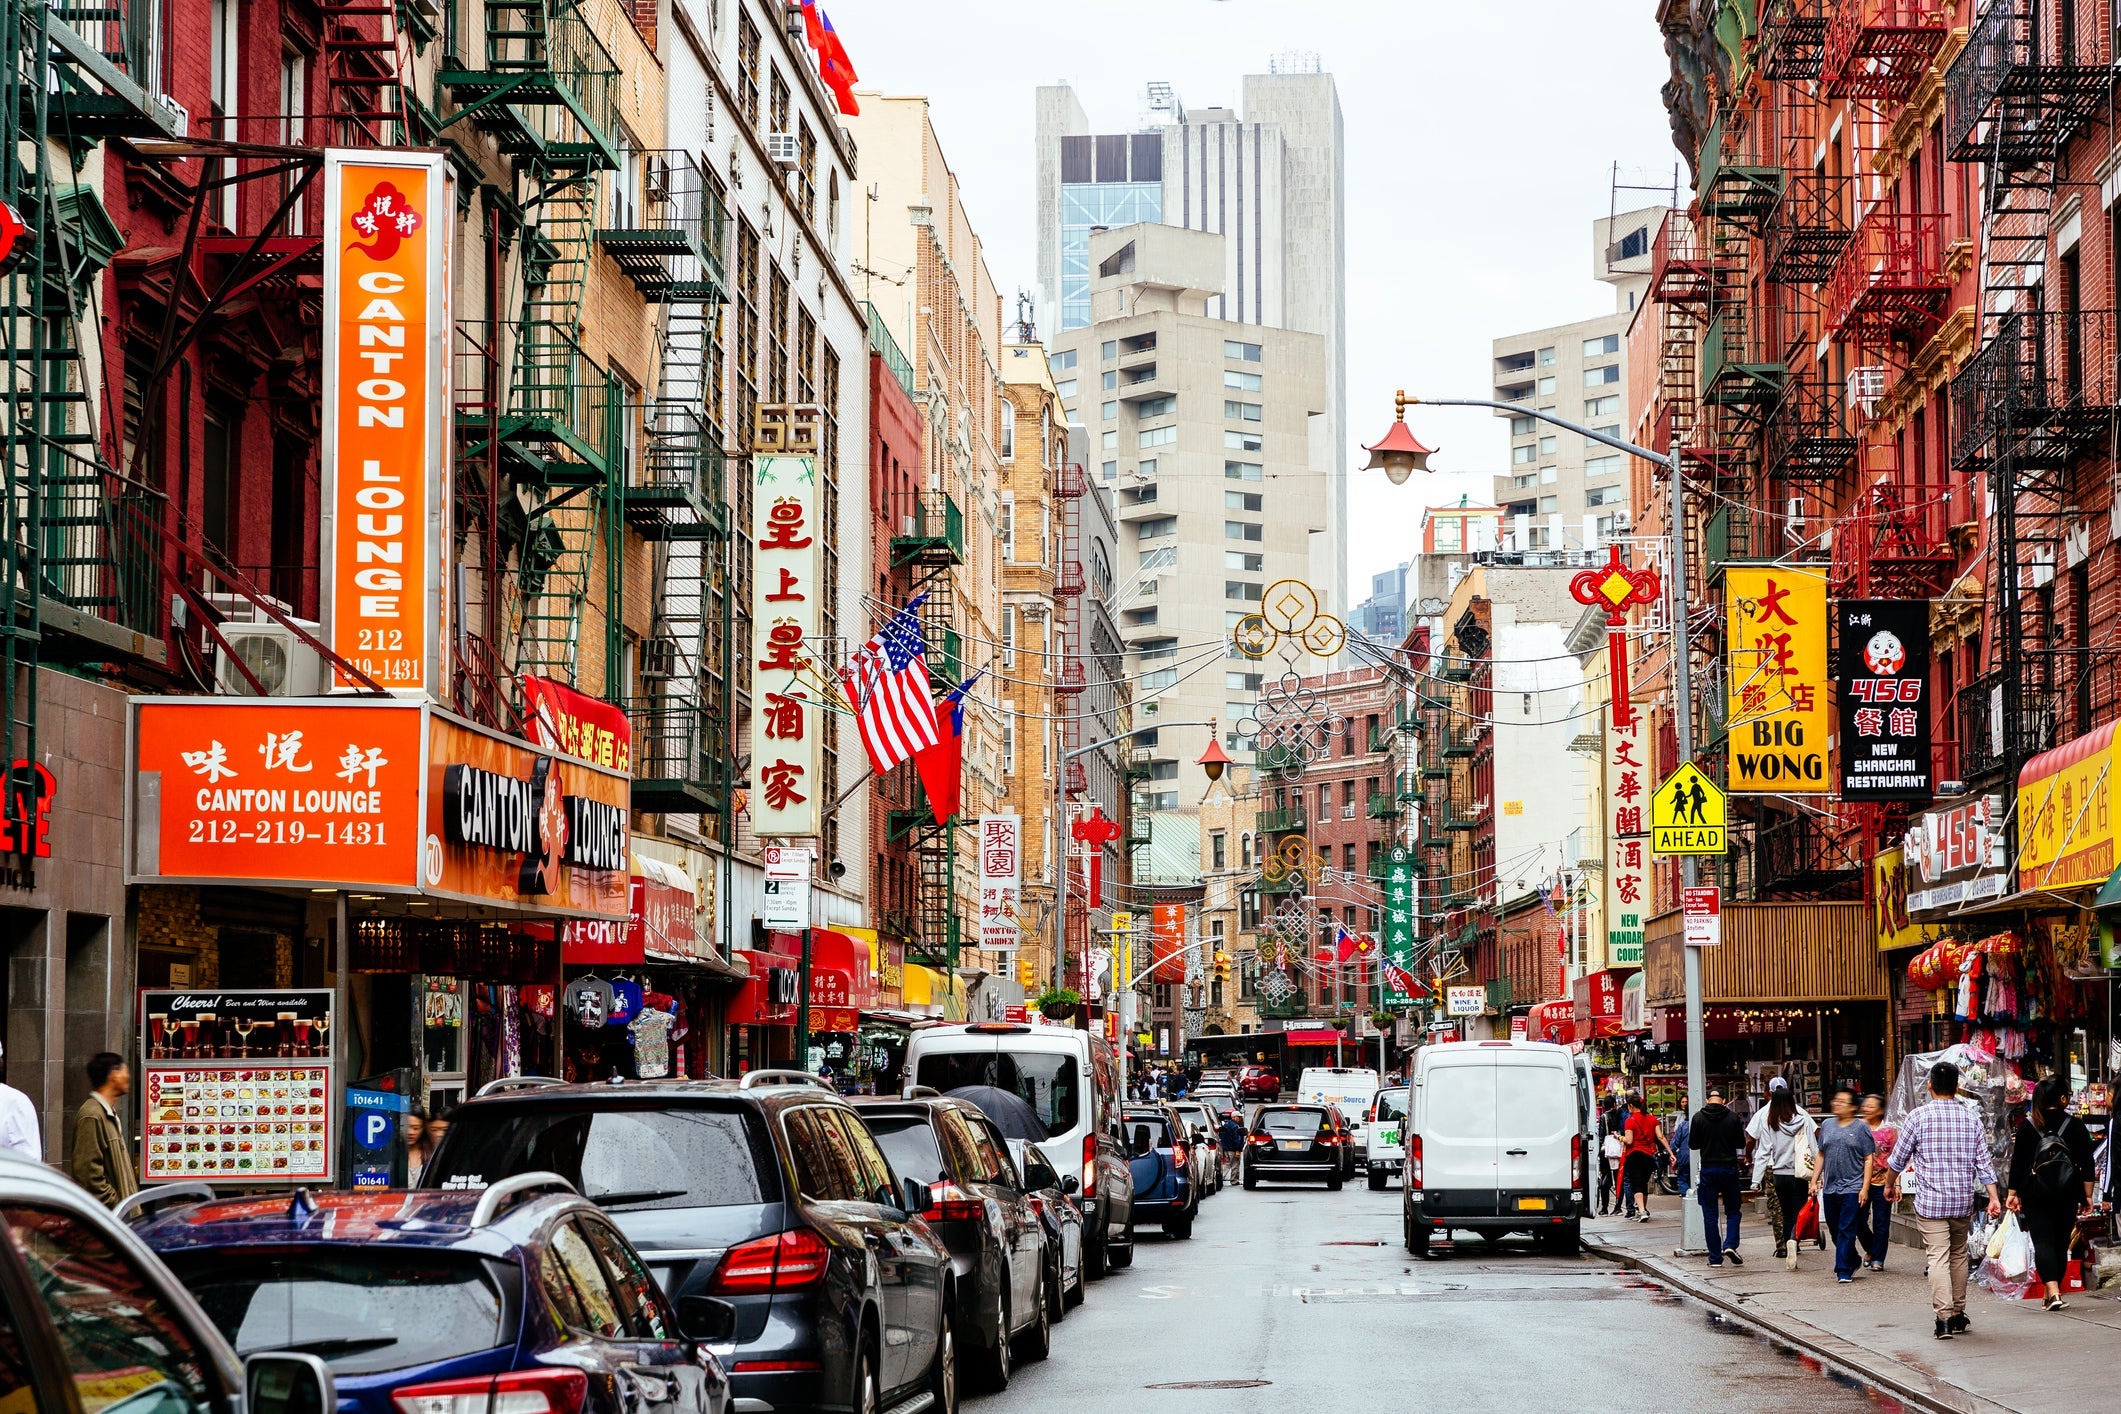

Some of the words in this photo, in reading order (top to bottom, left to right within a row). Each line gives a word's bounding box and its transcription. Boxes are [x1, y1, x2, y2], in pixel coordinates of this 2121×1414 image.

[358, 272, 405, 428] CANTON
[356, 459, 405, 618] LOUNGE
[358, 628, 403, 651] 212
[1755, 579, 1799, 677] 大旺
[758, 496, 813, 811] 皇上皇酒家
[1849, 678, 1922, 703] 456
[1752, 720, 1804, 747] BIG
[1854, 708, 1918, 737] 餐館
[1872, 744, 1898, 756] NEW
[1736, 753, 1823, 781] WONG
[1854, 759, 1916, 772] SHANGHAI
[1846, 774, 1927, 789] RESTAURANT
[197, 788, 286, 813] CANTON
[293, 789, 381, 814] LOUNGE
[461, 763, 532, 853] CANTON
[189, 819, 388, 846] 212-219-1431
[574, 796, 627, 871] LOUNGE
[1660, 831, 1718, 847] AHEAD
[1936, 804, 1977, 873] 456
[2089, 844, 2112, 877] STORE
[768, 881, 776, 894] 2
[982, 927, 1017, 935] WONTON
[1620, 913, 1639, 928] NEW
[984, 937, 1015, 946] GARDEN
[1616, 947, 1643, 962] COURT
[171, 995, 222, 1011] Cheers!
[225, 999, 241, 1007] Beer
[243, 999, 256, 1007] and
[258, 999, 275, 1007] Wine
[277, 998, 308, 1006] available
[1601, 974, 1616, 1014] 批發
[354, 1096, 384, 1105] 101641
[367, 1115, 387, 1144] P
[358, 1177, 385, 1185] 101641
